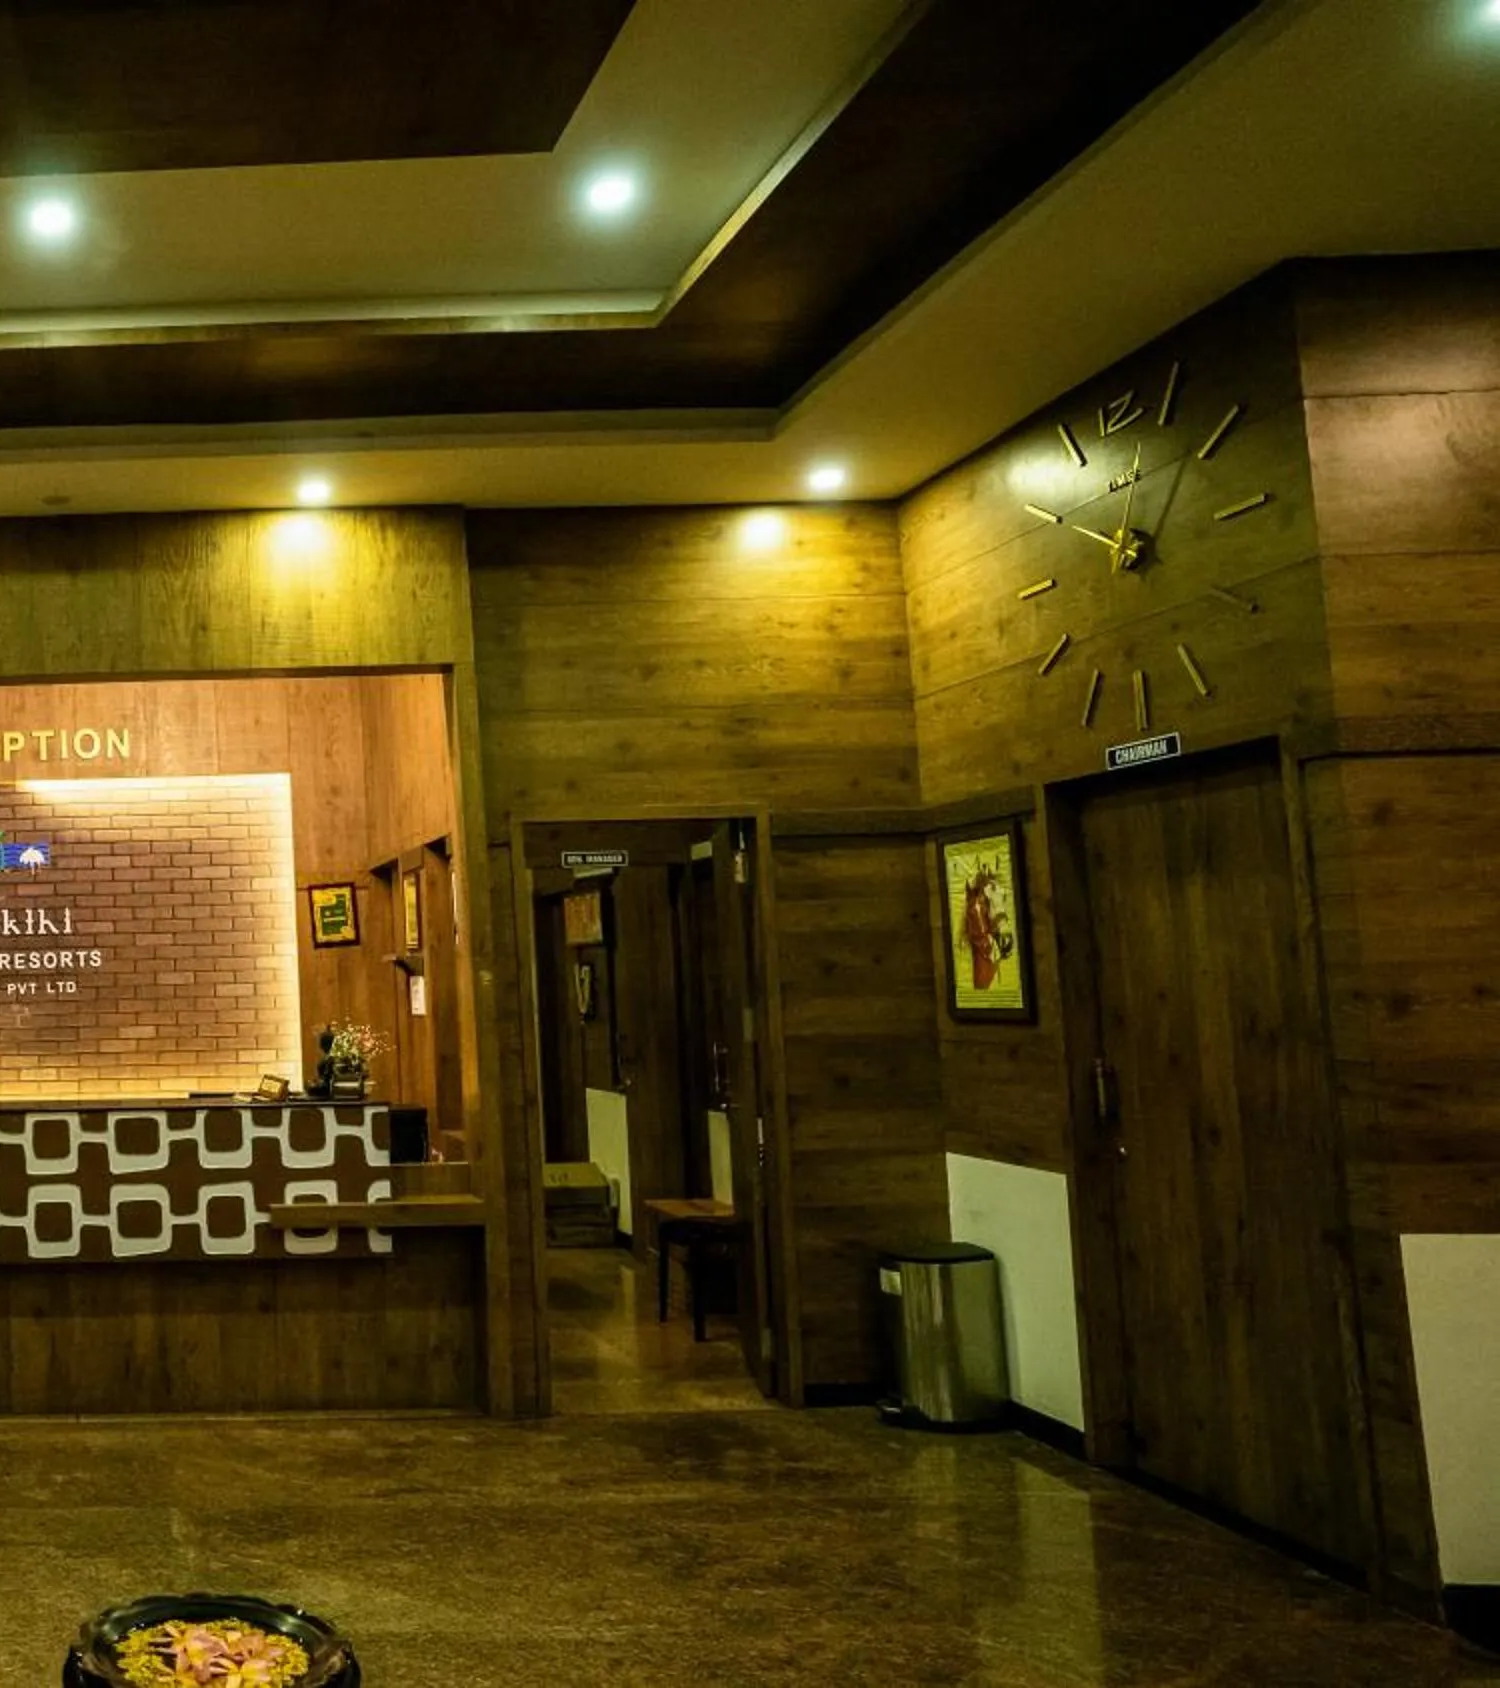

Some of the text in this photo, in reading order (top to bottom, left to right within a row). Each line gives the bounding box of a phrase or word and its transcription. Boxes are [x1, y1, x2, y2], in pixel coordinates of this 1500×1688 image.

[1116, 739, 1167, 764] CHAIRMAN
[7, 983, 37, 995] PVT
[47, 981, 77, 994] LTD
